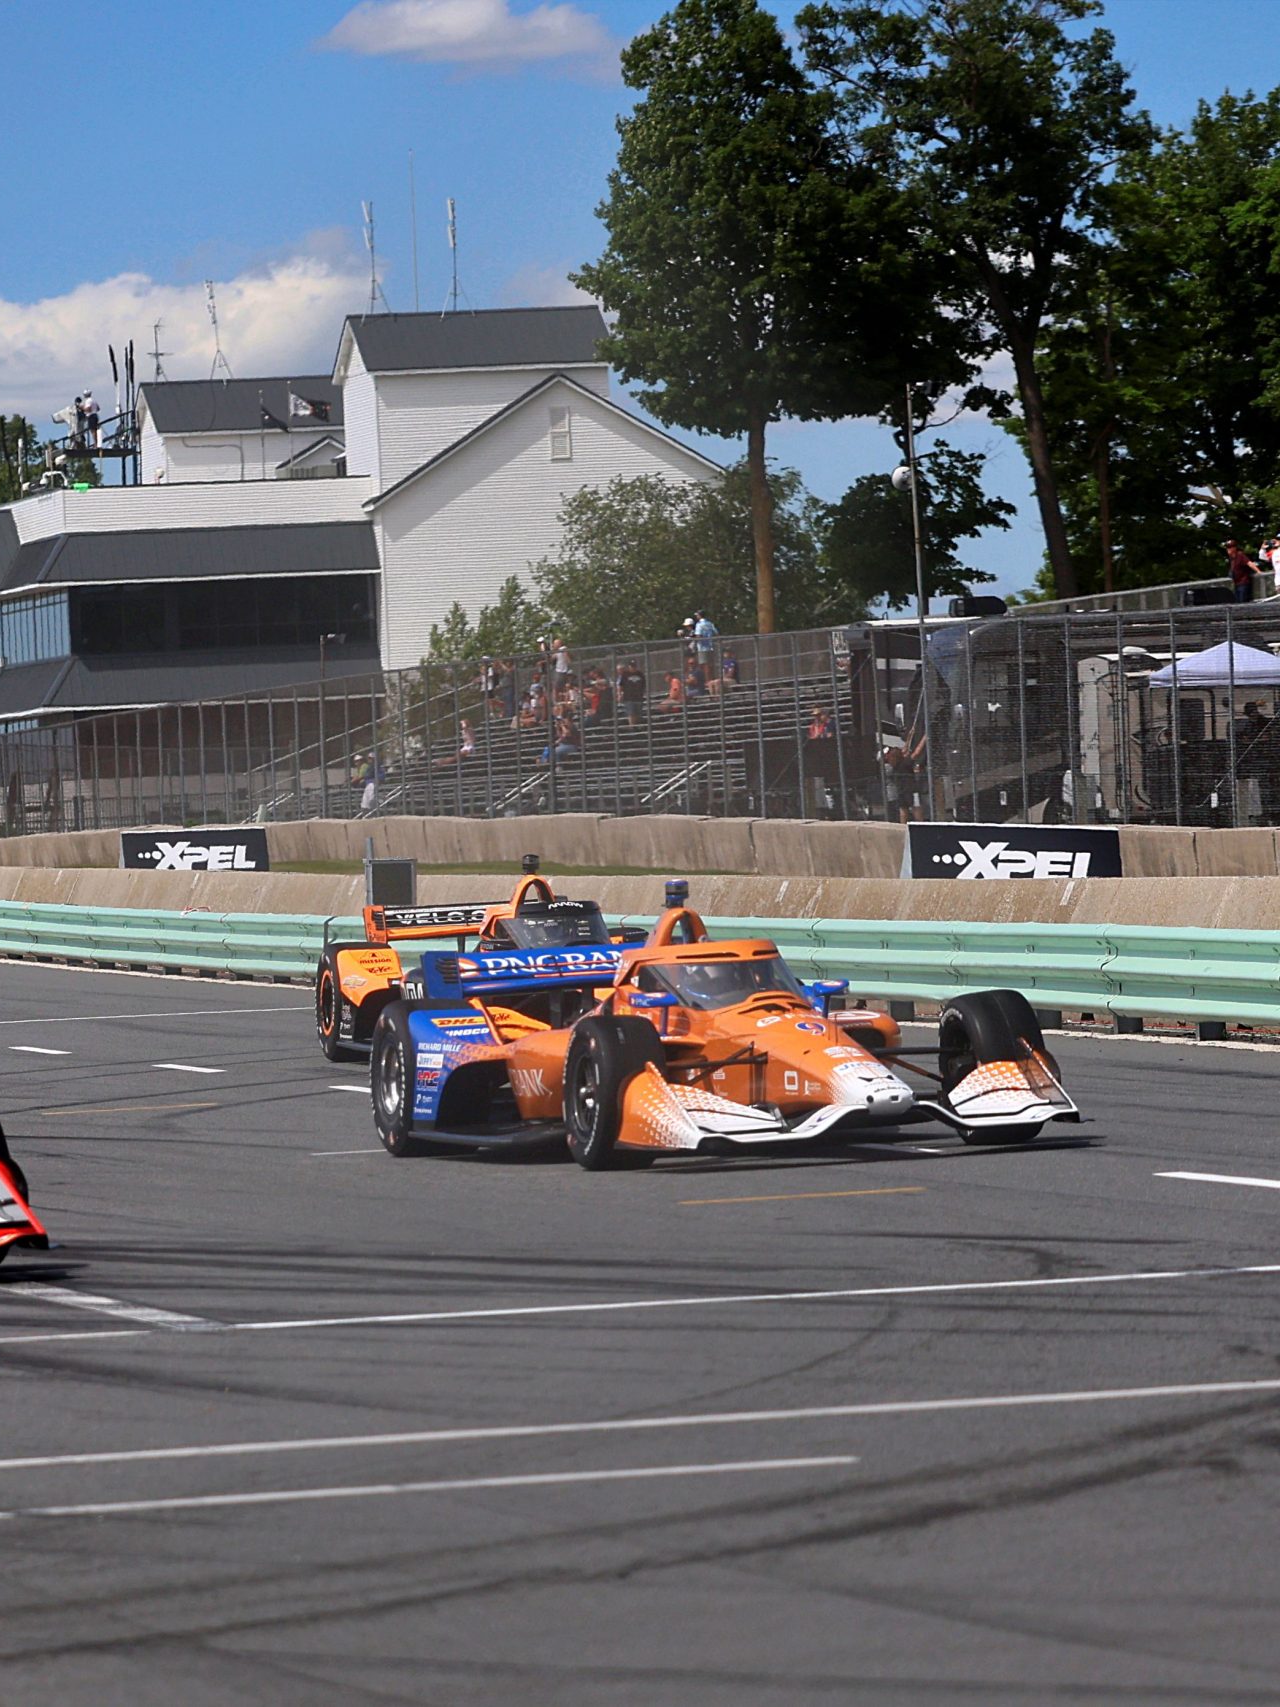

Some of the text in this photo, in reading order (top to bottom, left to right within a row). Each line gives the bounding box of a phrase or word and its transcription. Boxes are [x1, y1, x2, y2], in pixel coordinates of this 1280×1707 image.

[155, 841, 256, 870] XPEL
[481, 950, 623, 976] PNC BAN
[437, 1018, 479, 1027] DHL
